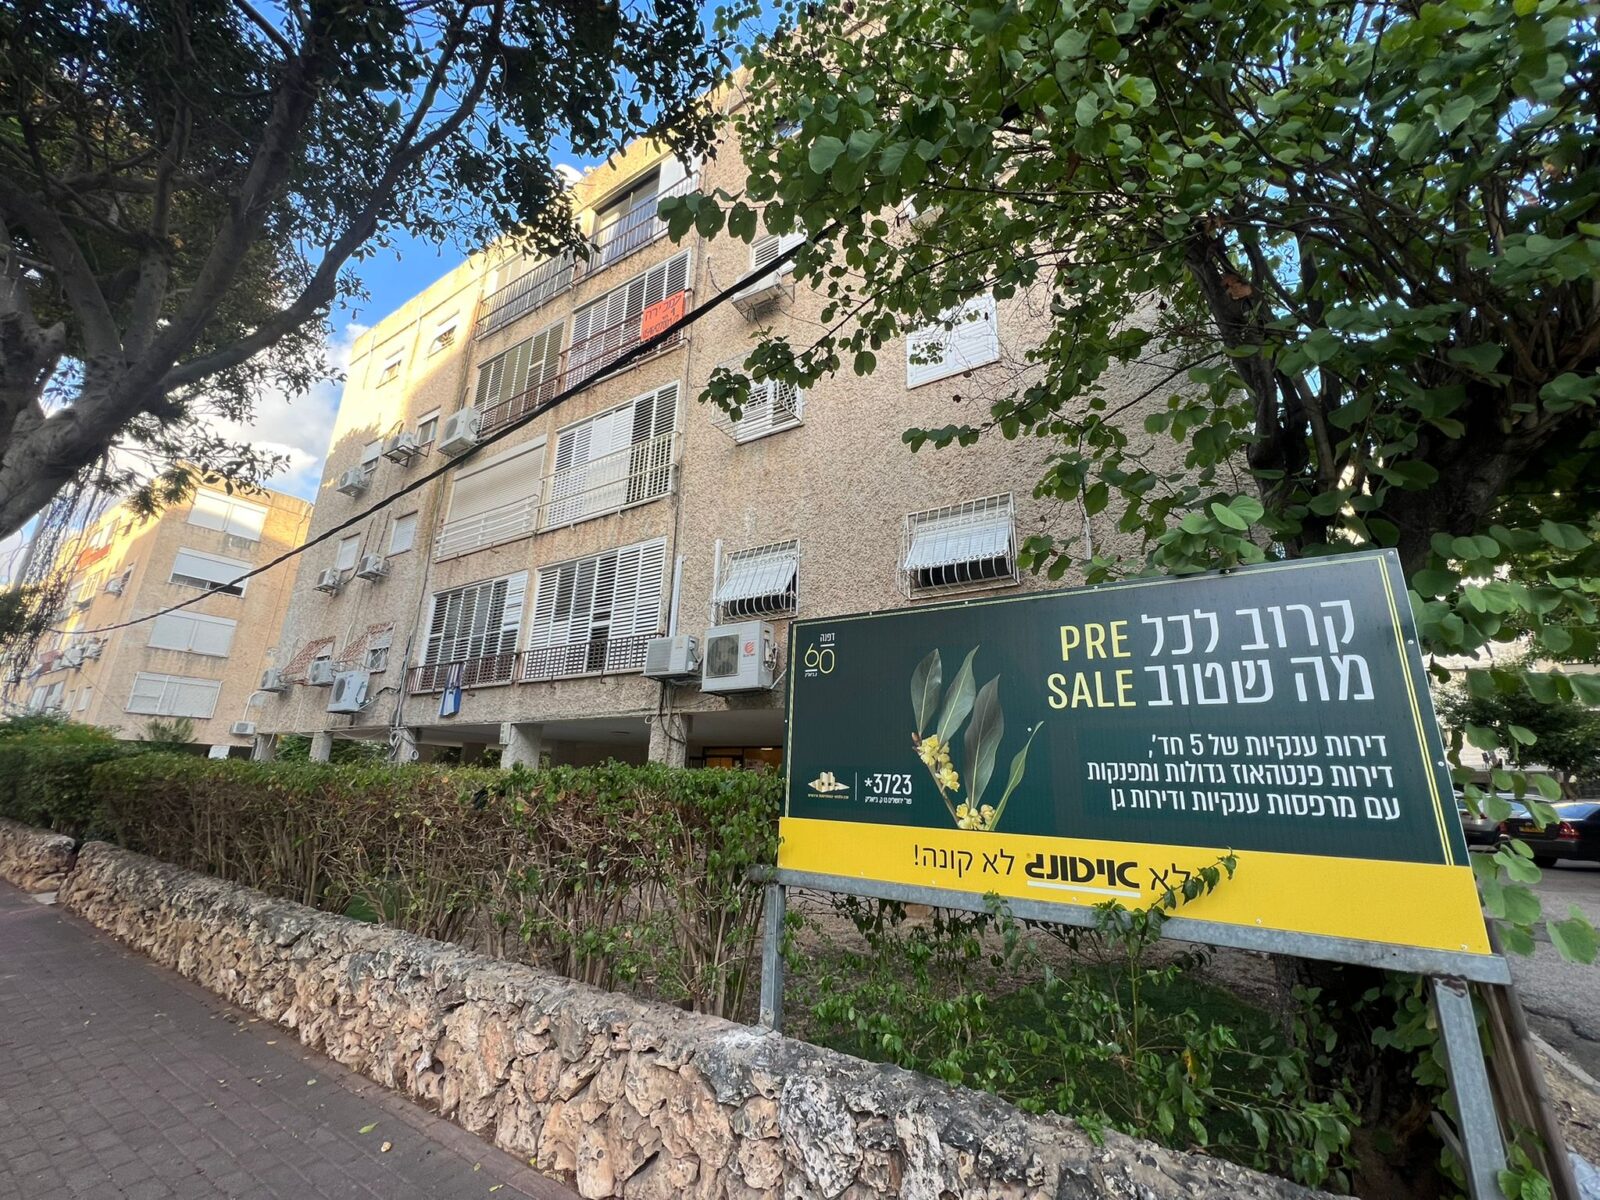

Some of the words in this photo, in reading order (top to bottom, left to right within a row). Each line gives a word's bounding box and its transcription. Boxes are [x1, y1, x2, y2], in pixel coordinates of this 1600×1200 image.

[820, 632, 835, 642] דפנה
[1141, 608, 1220, 657] לכל
[1235, 600, 1355, 653] קרוב
[1060, 620, 1131, 661] PRE
[804, 642, 835, 674] 60
[1047, 669, 1137, 710] SALE
[1144, 659, 1274, 706] שטוב
[1290, 654, 1375, 702] מה
[1189, 733, 1204, 756] 5
[1208, 734, 1239, 756] של
[1244, 735, 1318, 760] ענקיות
[1324, 735, 1388, 757] דירות
[1087, 762, 1160, 784] ומפנקות
[1164, 761, 1226, 784] גדולות
[1230, 764, 1324, 786] פנטהאוז
[1329, 765, 1394, 788] דירות
[1110, 788, 1126, 811] גן
[1130, 789, 1186, 810] ודירות
[1191, 791, 1260, 816] ענקיות
[1266, 793, 1357, 818] מרפסות
[1363, 796, 1401, 820] עם
[913, 844, 973, 879] קונה!
[982, 848, 1015, 876] לא
[1149, 863, 1191, 892] לא
